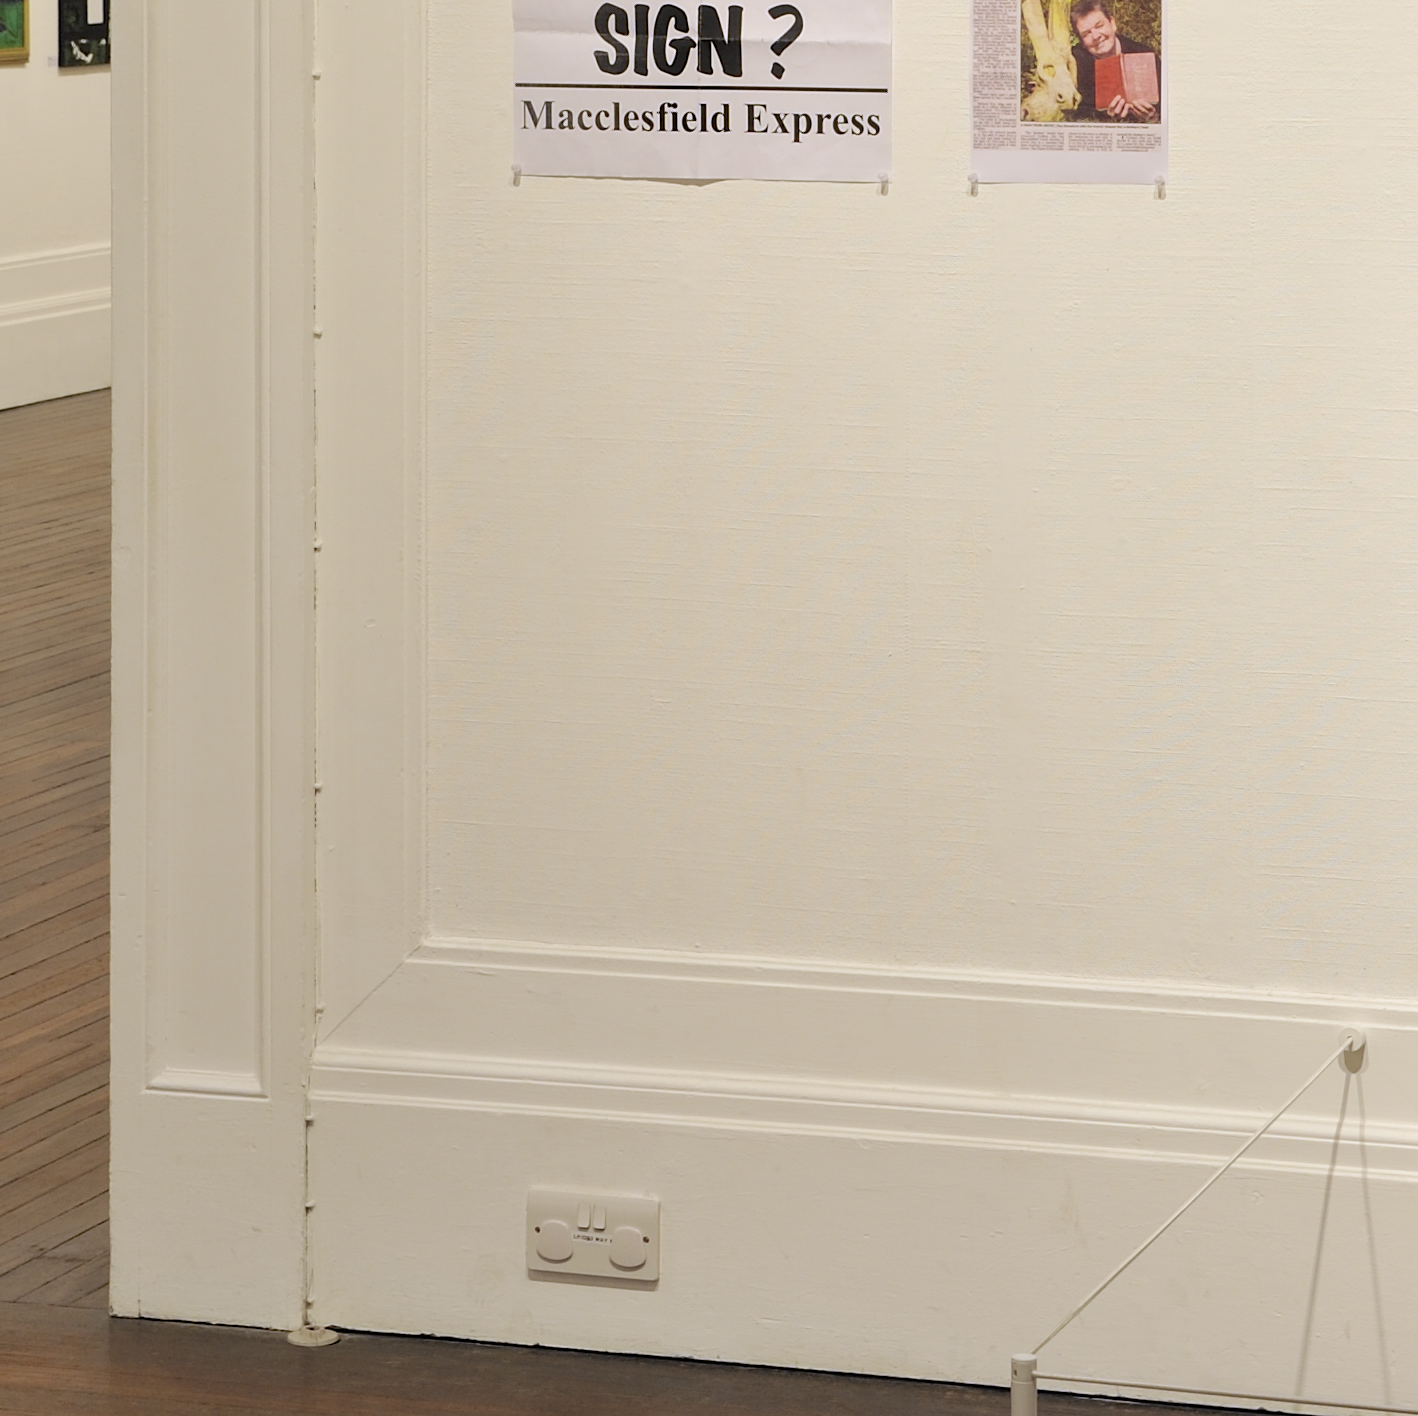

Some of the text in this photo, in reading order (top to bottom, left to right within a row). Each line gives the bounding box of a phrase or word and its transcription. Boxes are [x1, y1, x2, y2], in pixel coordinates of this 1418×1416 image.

[593, 2, 804, 80] SIGN ?
[521, 100, 881, 143] Macclesfield Express
